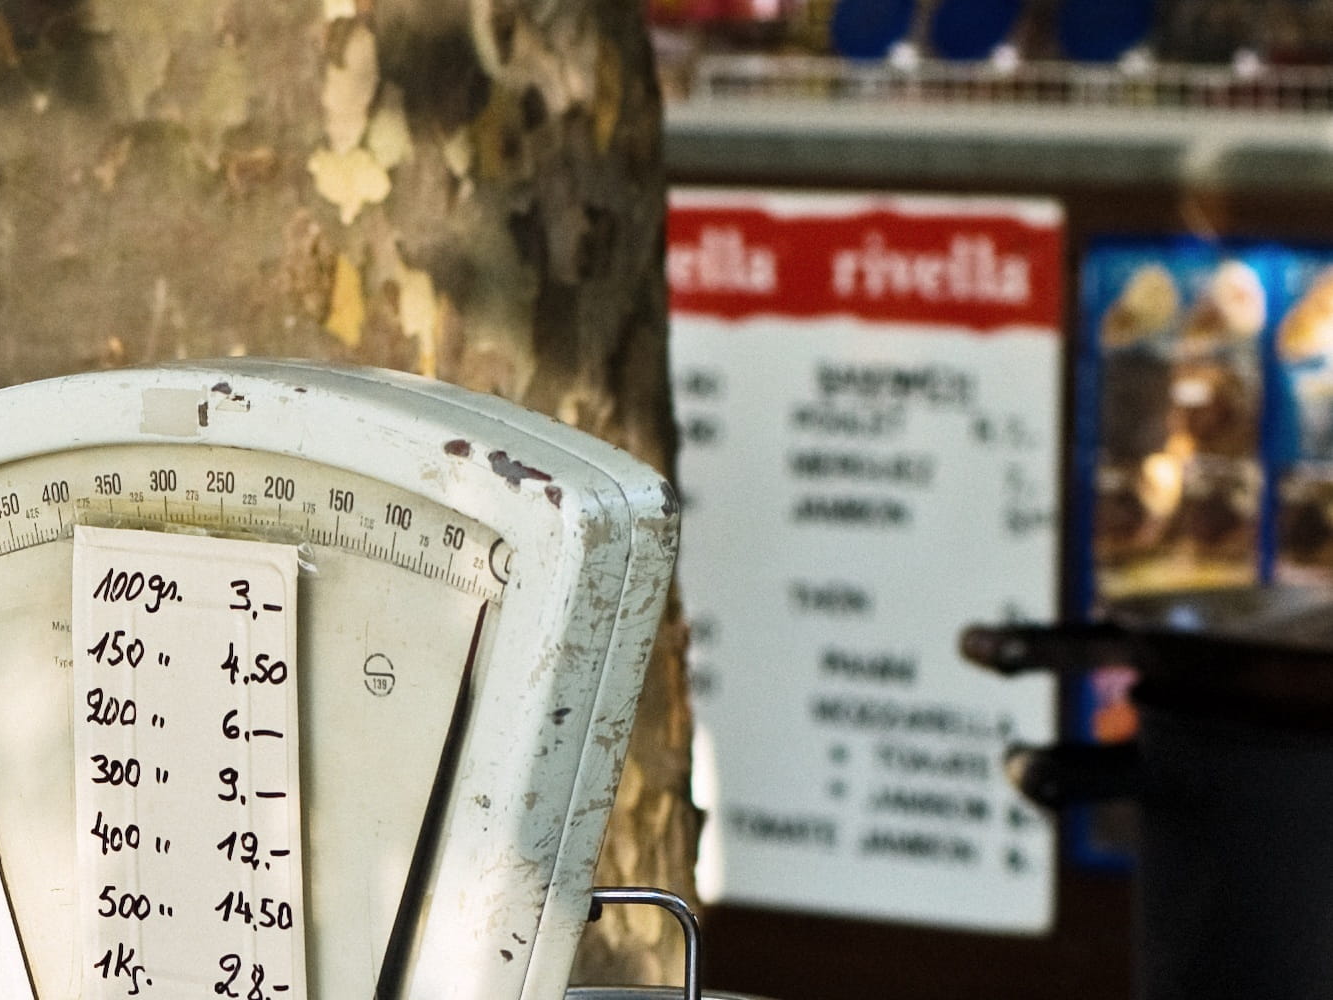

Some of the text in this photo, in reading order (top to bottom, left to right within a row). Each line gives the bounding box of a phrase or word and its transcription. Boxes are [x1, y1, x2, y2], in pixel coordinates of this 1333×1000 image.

[832, 230, 1032, 306] rivella
[42, 481, 70, 506] 400
[94, 473, 122, 496] 350
[150, 469, 177, 492] 300
[206, 470, 235, 494] 250
[264, 475, 295, 502] 200
[329, 487, 355, 514] 150
[385, 502, 412, 531] 100
[442, 523, 466, 551] 50
[185, 489, 199, 502] 275
[242, 493, 257, 506] 225
[302, 501, 316, 515] 175
[419, 534, 430, 548] 75
[473, 556, 484, 570] 25
[87, 630, 145, 669] 150
[220, 641, 288, 685] 4.50
[372, 677, 387, 690] 139
[86, 687, 137, 726] 200
[90, 754, 141, 787] 300
[90, 811, 141, 855] 400
[98, 885, 152, 920] 500
